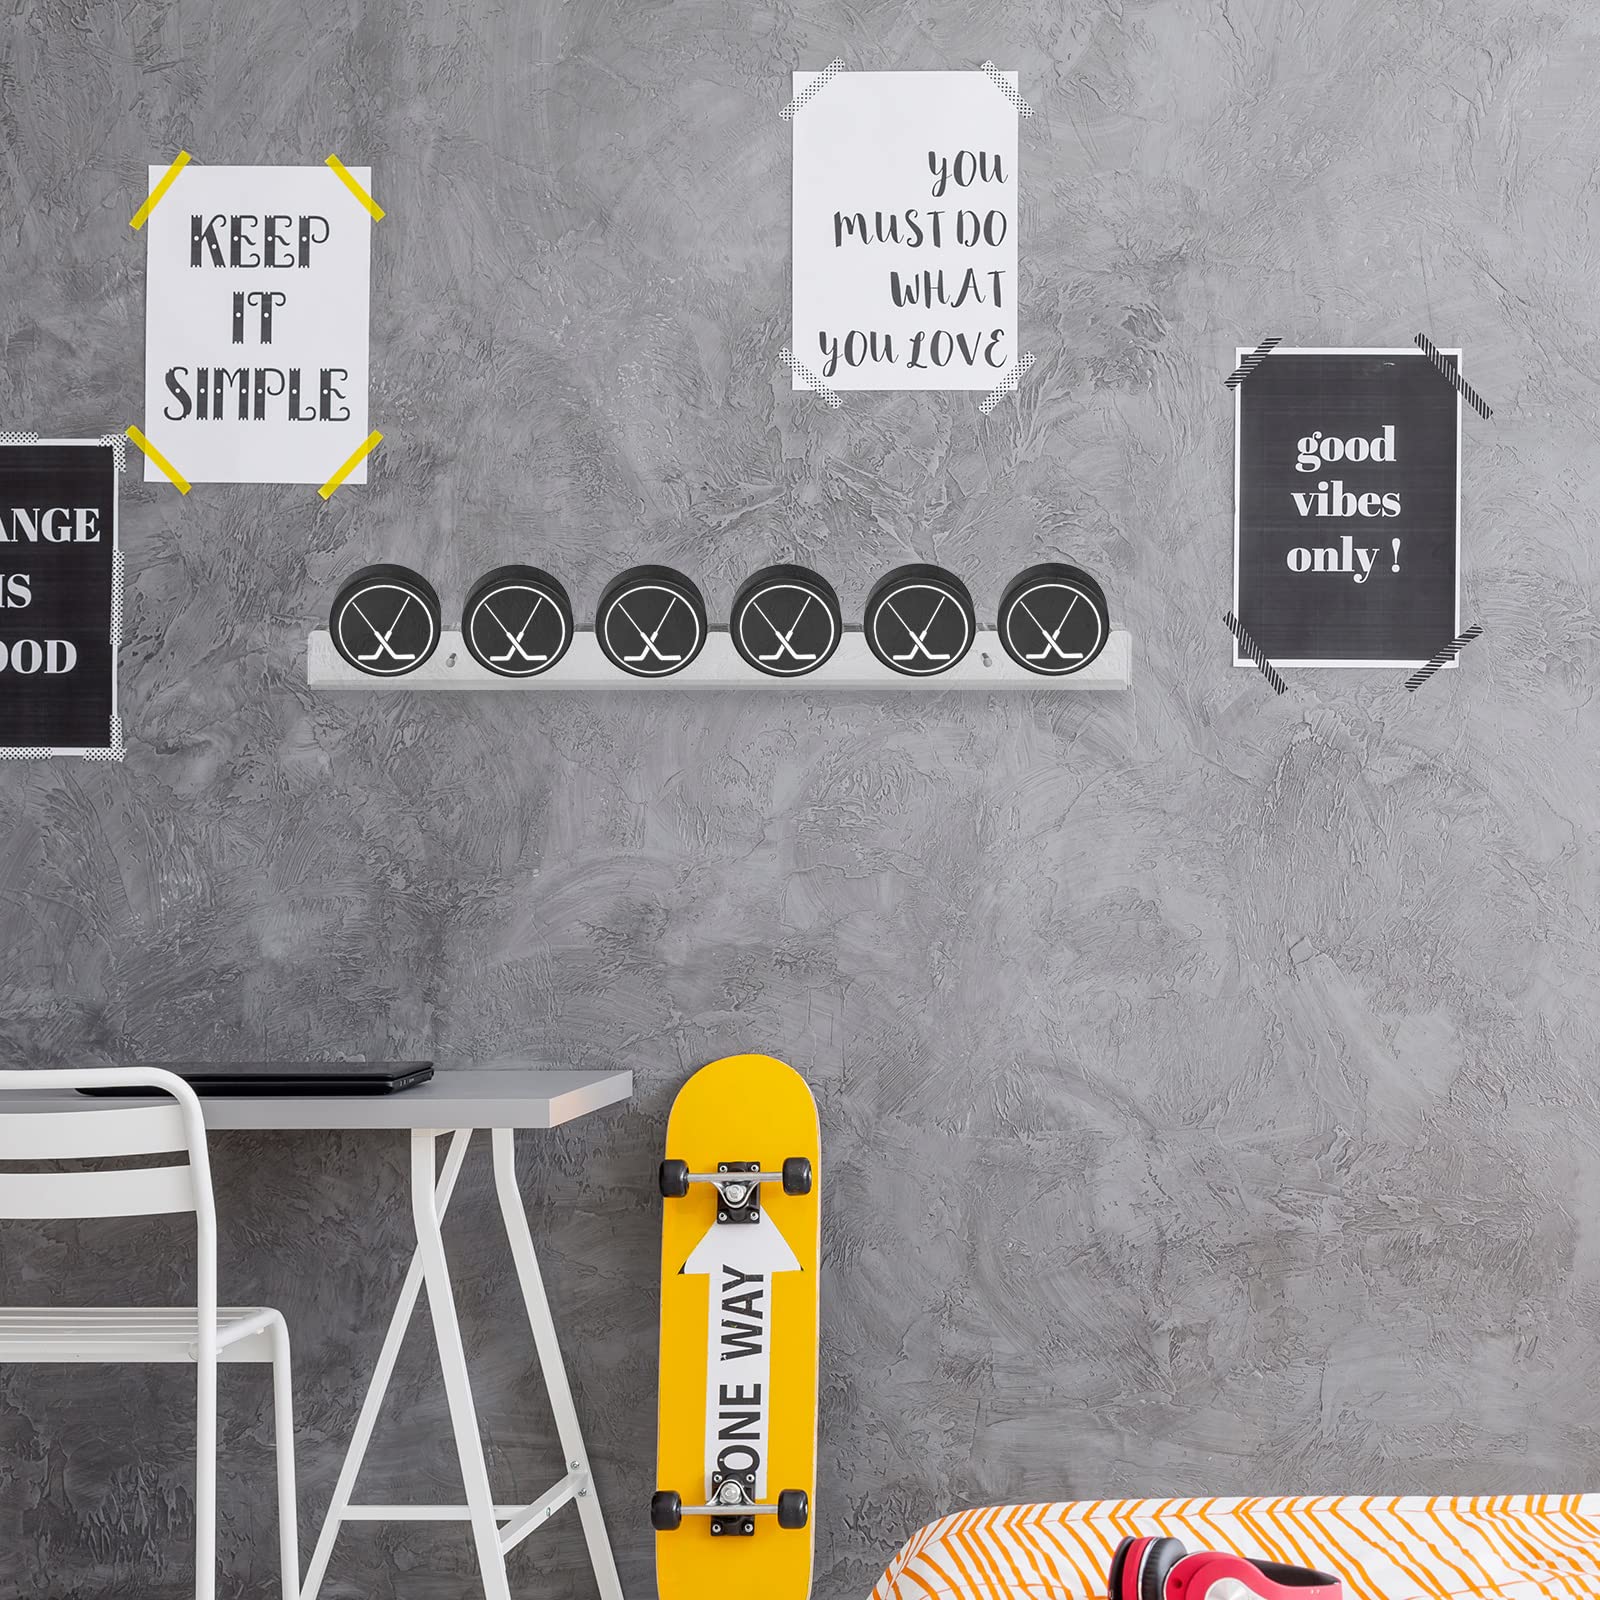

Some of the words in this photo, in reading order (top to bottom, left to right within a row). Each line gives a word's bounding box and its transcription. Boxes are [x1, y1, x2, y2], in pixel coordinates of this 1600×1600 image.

[190, 214, 330, 269] KEEP
[956, 209, 1007, 248] DO
[889, 267, 1006, 309] WHAT
[231, 291, 287, 345] IT
[906, 328, 1008, 370] LOVE
[163, 366, 351, 422] SIMPLE
[1295, 424, 1397, 473] good
[1290, 479, 1402, 518] vibes
[0, 639, 77, 674] OD
[720, 1264, 764, 1361] WAY
[717, 1383, 762, 1473] ONE
